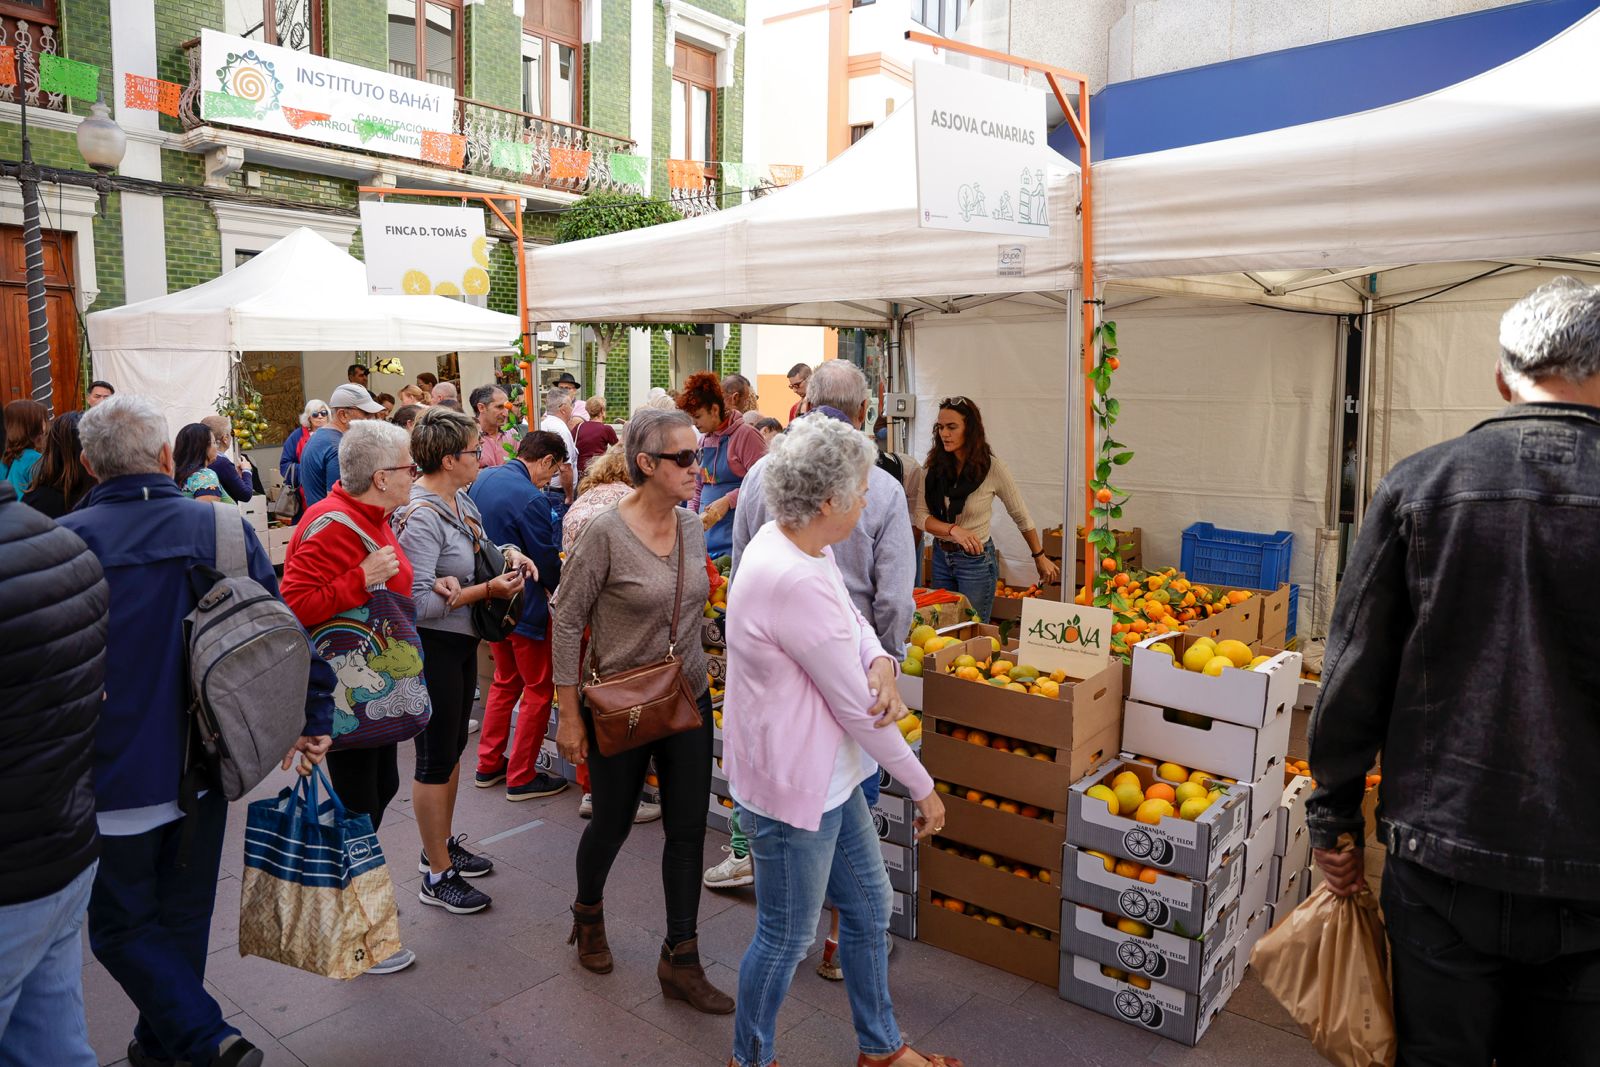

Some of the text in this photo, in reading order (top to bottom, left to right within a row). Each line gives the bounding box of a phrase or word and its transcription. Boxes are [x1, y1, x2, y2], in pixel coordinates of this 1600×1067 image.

[296, 66, 385, 100] INSTITUTO
[931, 109, 1035, 146] ASJOVA CANARIAS
[385, 225, 468, 238] FINCA D. TOMÁS
[1028, 617, 1100, 648] ASJOVA
[1136, 824, 1166, 837] NARANJAS
[1176, 838, 1194, 847] TELDE
[1131, 884, 1161, 898] NARANJAS
[1171, 898, 1189, 909] TELDE
[1129, 936, 1159, 950] NARANJAS
[1169, 951, 1186, 961] TELDE
[1127, 985, 1156, 1000] NARANJAS
[1165, 1002, 1182, 1012] TELDE
